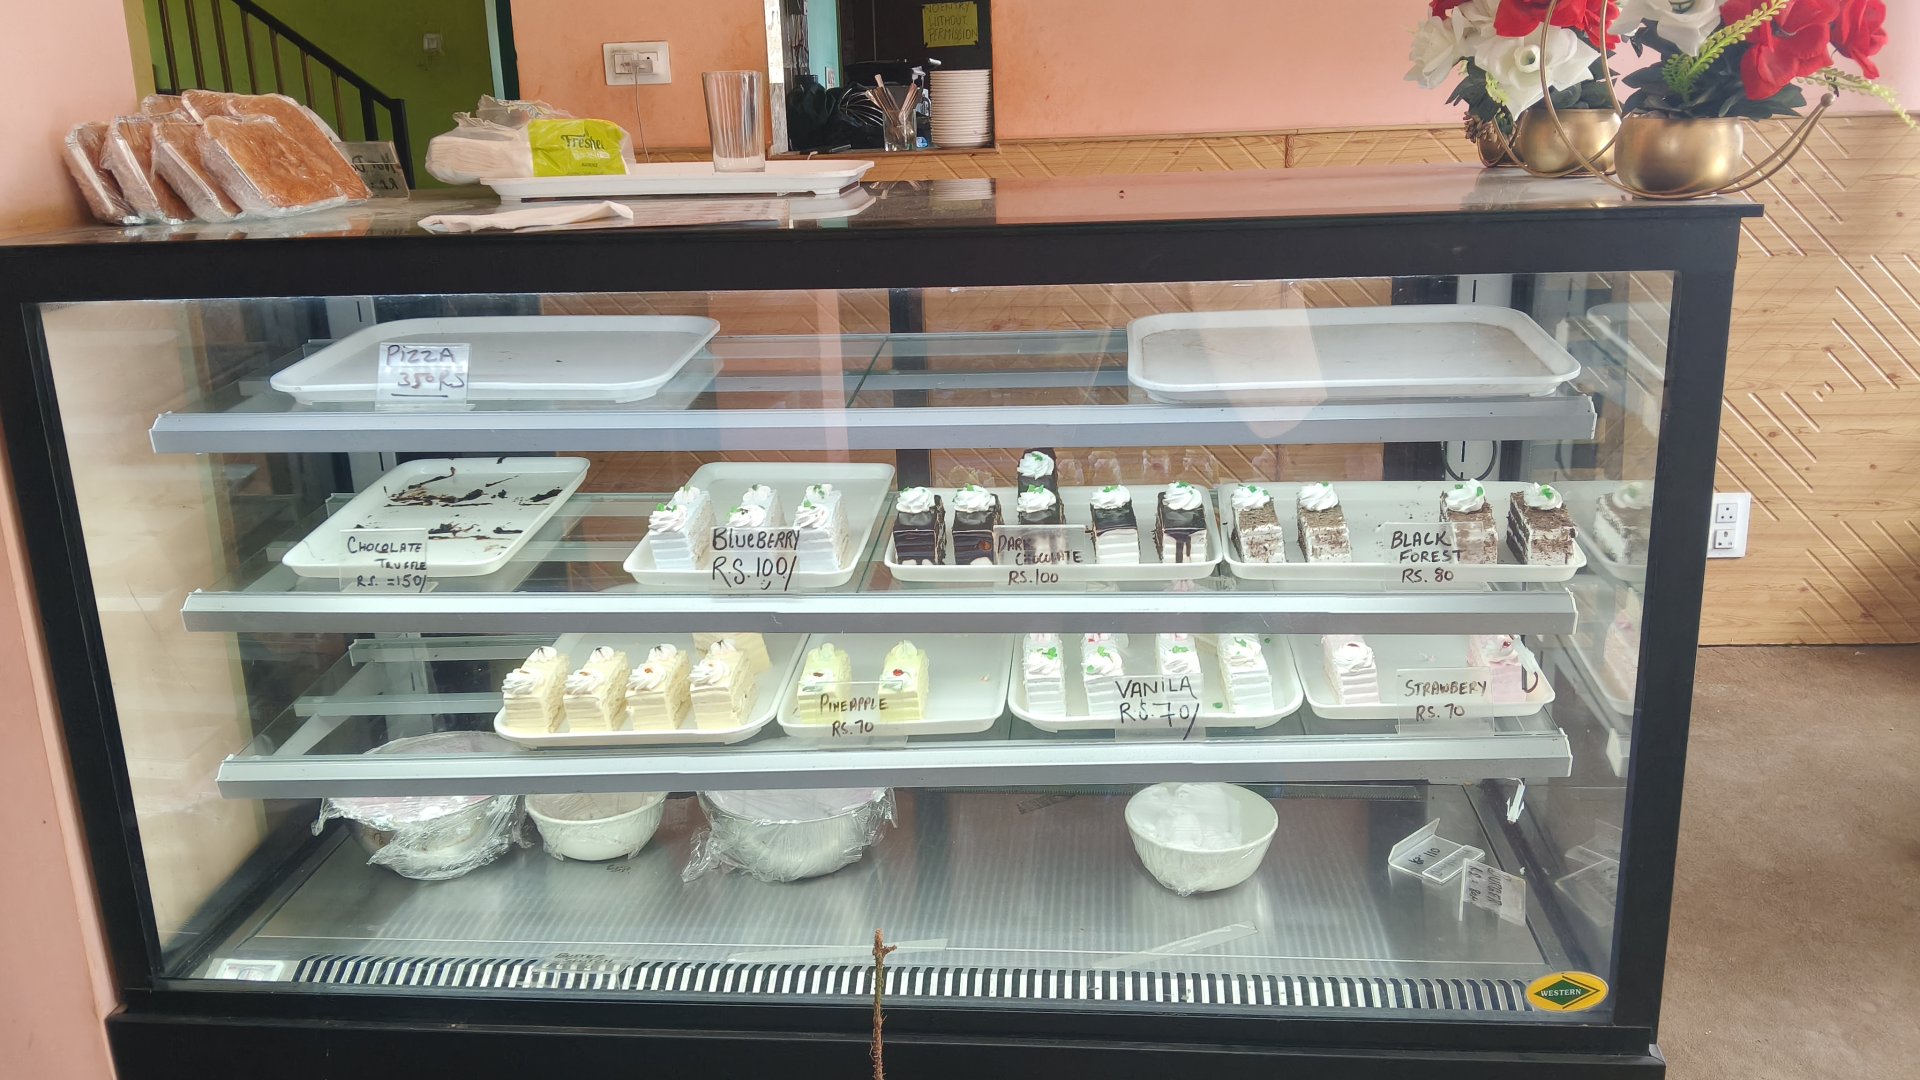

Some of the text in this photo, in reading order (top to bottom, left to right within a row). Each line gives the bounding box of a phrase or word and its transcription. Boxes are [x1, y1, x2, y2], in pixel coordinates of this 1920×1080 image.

[929, 28, 977, 41] PERMISSION
[347, 536, 423, 554] CHOCOLATE
[1390, 530, 1452, 549] BLACK
[374, 558, 427, 570] TRUFFLE
[1400, 549, 1466, 563] FOREST
[1405, 679, 1487, 697] STRAWBERY
[820, 693, 888, 715] PINEAPPLE
[1541, 988, 1582, 997] WESTERN
